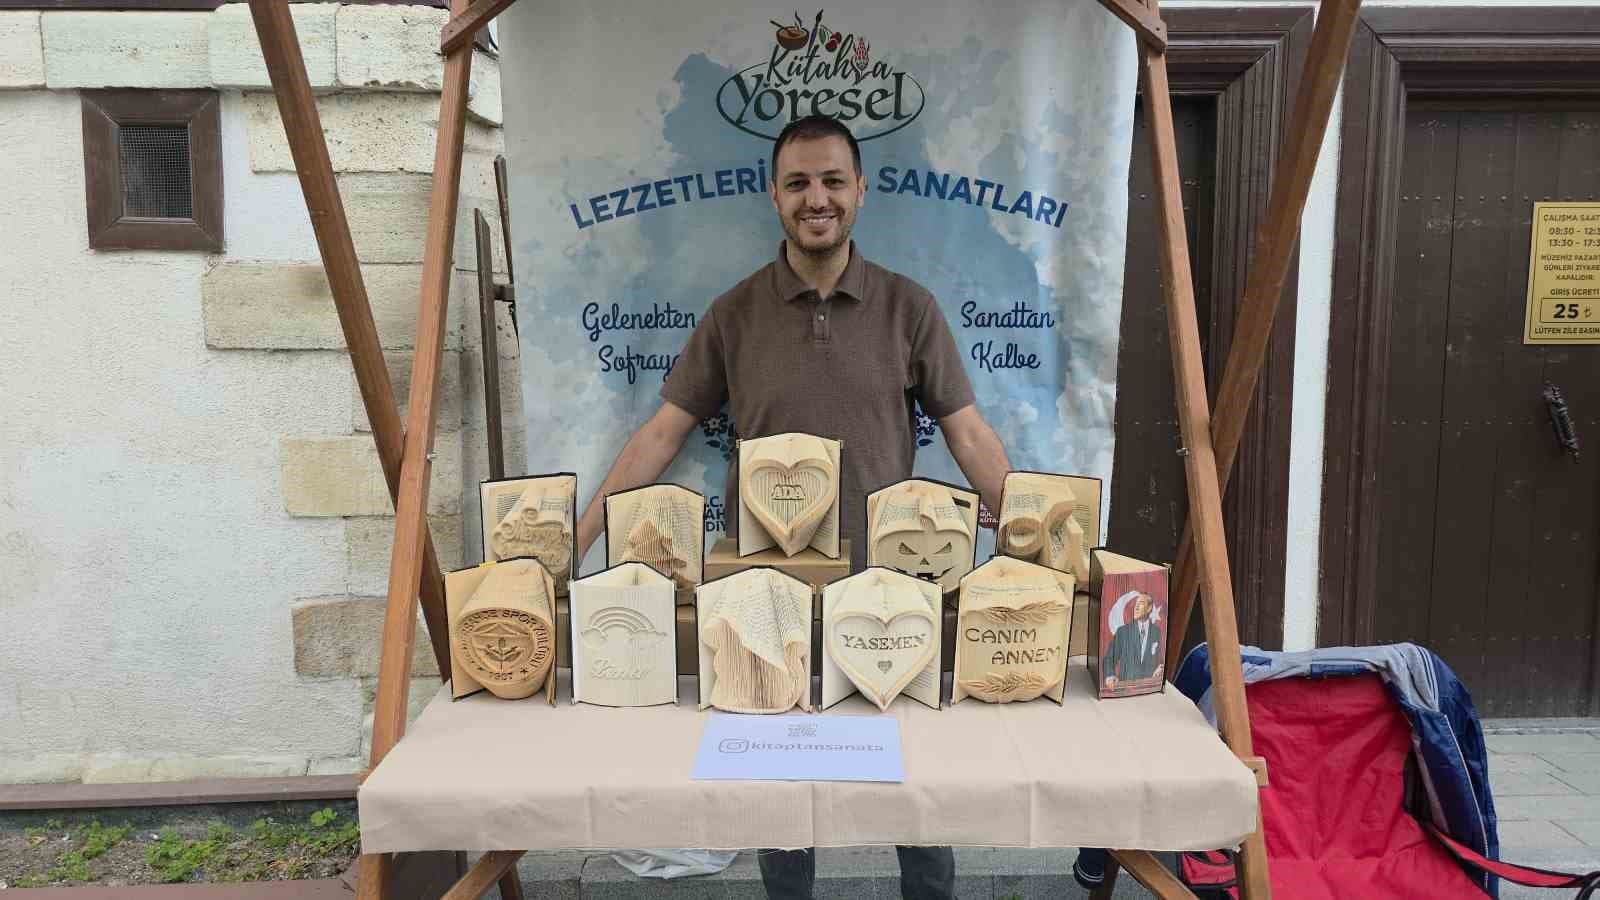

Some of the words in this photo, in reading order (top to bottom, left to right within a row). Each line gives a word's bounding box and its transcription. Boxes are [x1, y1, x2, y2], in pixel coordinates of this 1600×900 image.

[734, 72, 912, 124] Yöresel
[570, 158, 767, 229] LEZZETLERİ
[877, 166, 1068, 228] SANATLARI
[582, 302, 696, 342] Gelenekten
[960, 300, 1055, 328] Sanattan
[1553, 303, 1579, 319] 25
[971, 340, 1041, 373] Kalbe
[840, 633, 927, 650] YASEMEN
[965, 628, 1037, 643] CANIM
[992, 645, 1061, 665] ANNEM
